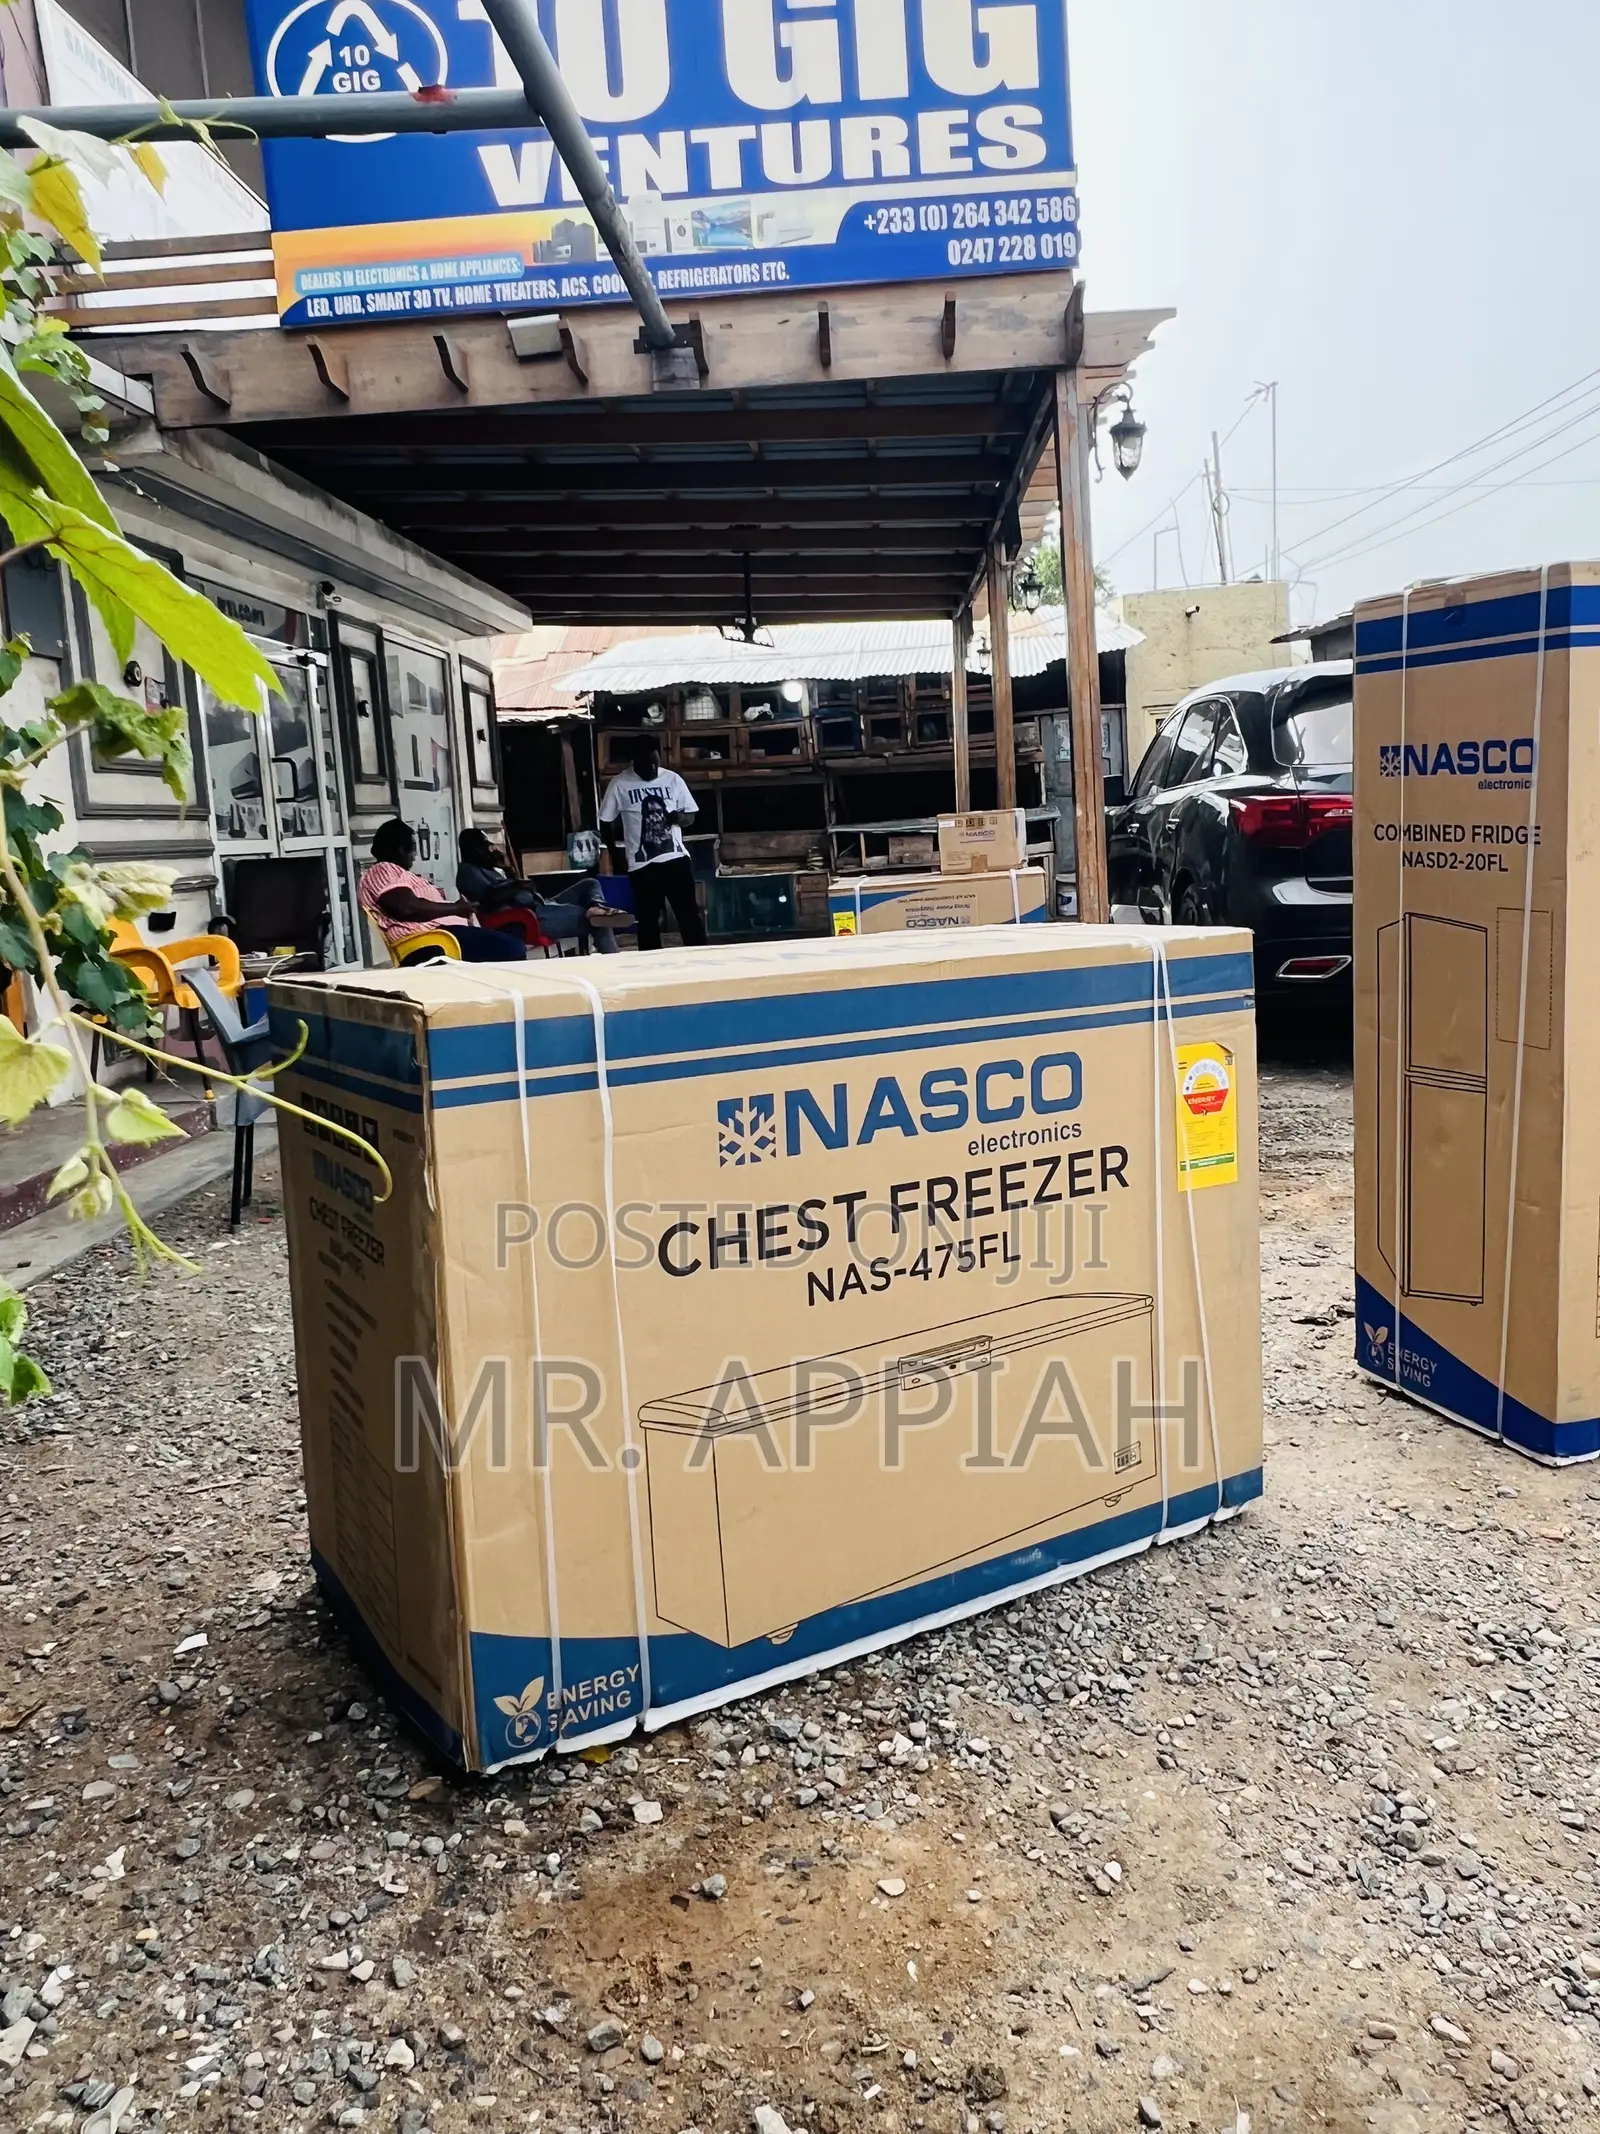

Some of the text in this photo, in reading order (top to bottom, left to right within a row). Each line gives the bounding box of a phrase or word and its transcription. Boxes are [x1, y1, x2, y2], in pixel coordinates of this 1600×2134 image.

[339, 44, 370, 68] 10
[722, 0, 1040, 110] GIG
[332, 69, 382, 93] GIG
[863, 196, 1077, 234] +233 (0) 264 342 586
[947, 231, 1077, 265] 0247 228 019
[301, 271, 342, 291] DEALERS
[343, 270, 354, 287] IN
[355, 265, 420, 286] ELECTRONICS
[421, 266, 429, 280] &
[429, 261, 458, 280] HOME
[306, 297, 334, 318] LED,
[334, 294, 366, 315] UHD,
[366, 290, 411, 313] SMART
[413, 289, 432, 309] 3D
[433, 287, 454, 308] TV,
[454, 284, 493, 306] HOME
[493, 279, 561, 302] THEATERS,
[561, 275, 591, 298] ACS,
[658, 263, 760, 290] REFRIGERATORS
[761, 261, 790, 282] ETC.
[1402, 738, 1538, 777] NASCO
[1478, 778, 1535, 790] electronic
[1374, 824, 1542, 845] COMBINED FRIDGE
[1402, 851, 1509, 872] NASD2-20FL
[905, 916, 959, 928] NASCO
[784, 1052, 1083, 1157] NASCO
[967, 1122, 1083, 1157] electronics
[658, 1145, 1130, 1277] CHEST FREEZER
[806, 1232, 1021, 1307] NAS-475FL
[1387, 1342, 1438, 1375] EERGY
[1387, 1357, 1431, 1388] SVING
[546, 1663, 640, 1710] ENERGY
[547, 1690, 632, 1732] SAVING
